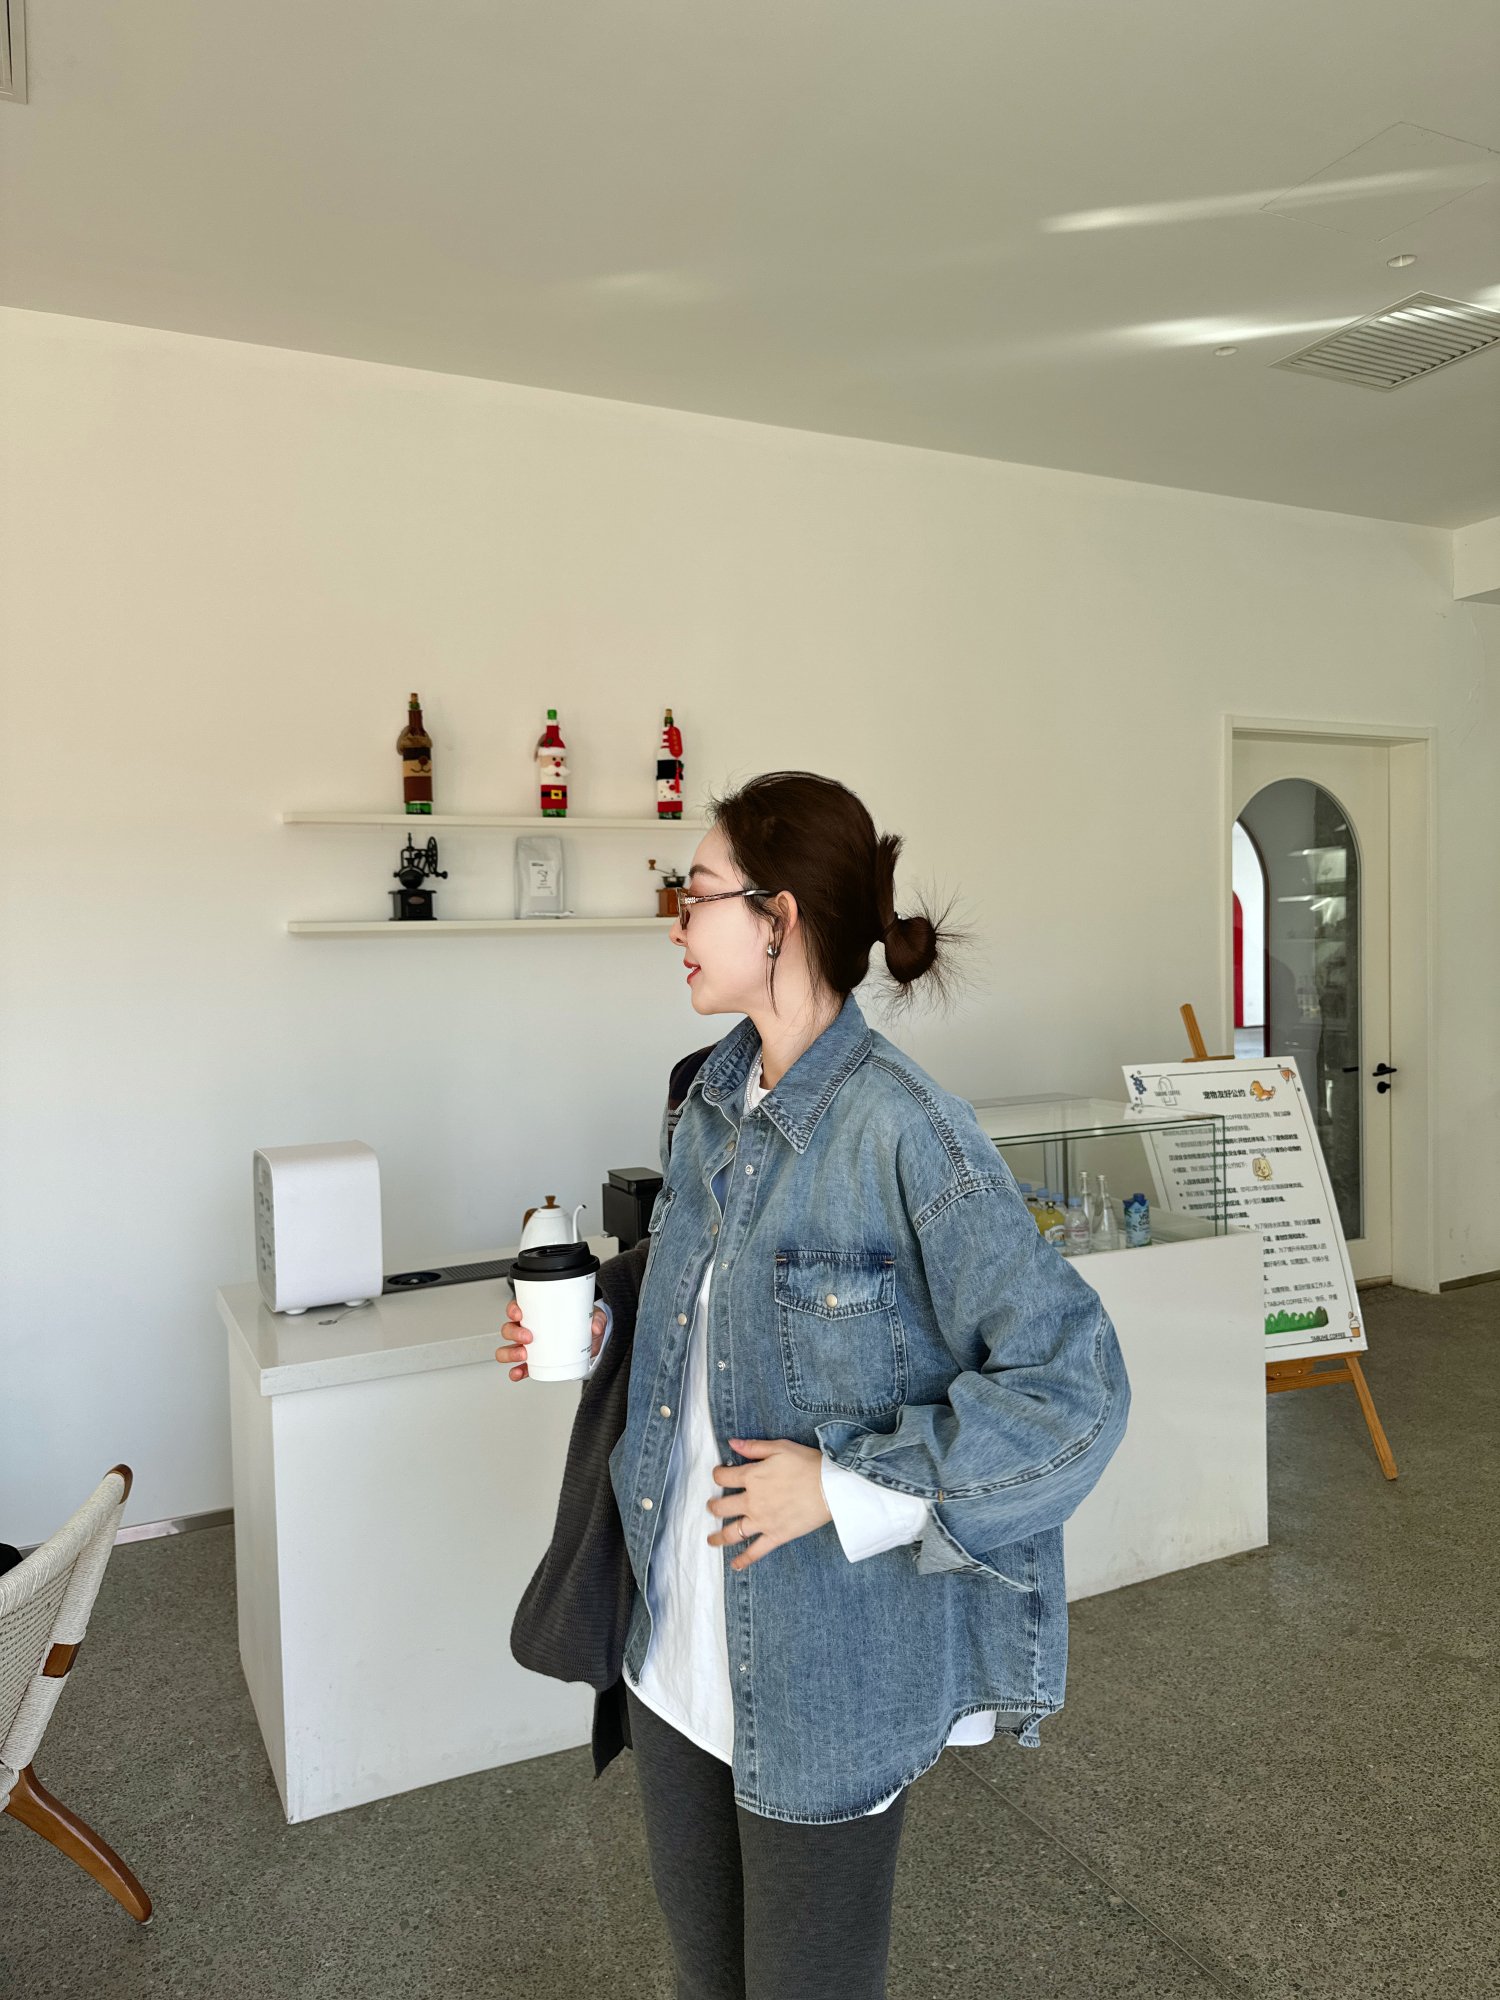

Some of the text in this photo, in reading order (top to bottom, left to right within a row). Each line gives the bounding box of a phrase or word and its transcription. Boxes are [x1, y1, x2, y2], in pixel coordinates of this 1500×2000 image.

[1202, 1089, 1246, 1100] 宠物友好公约
